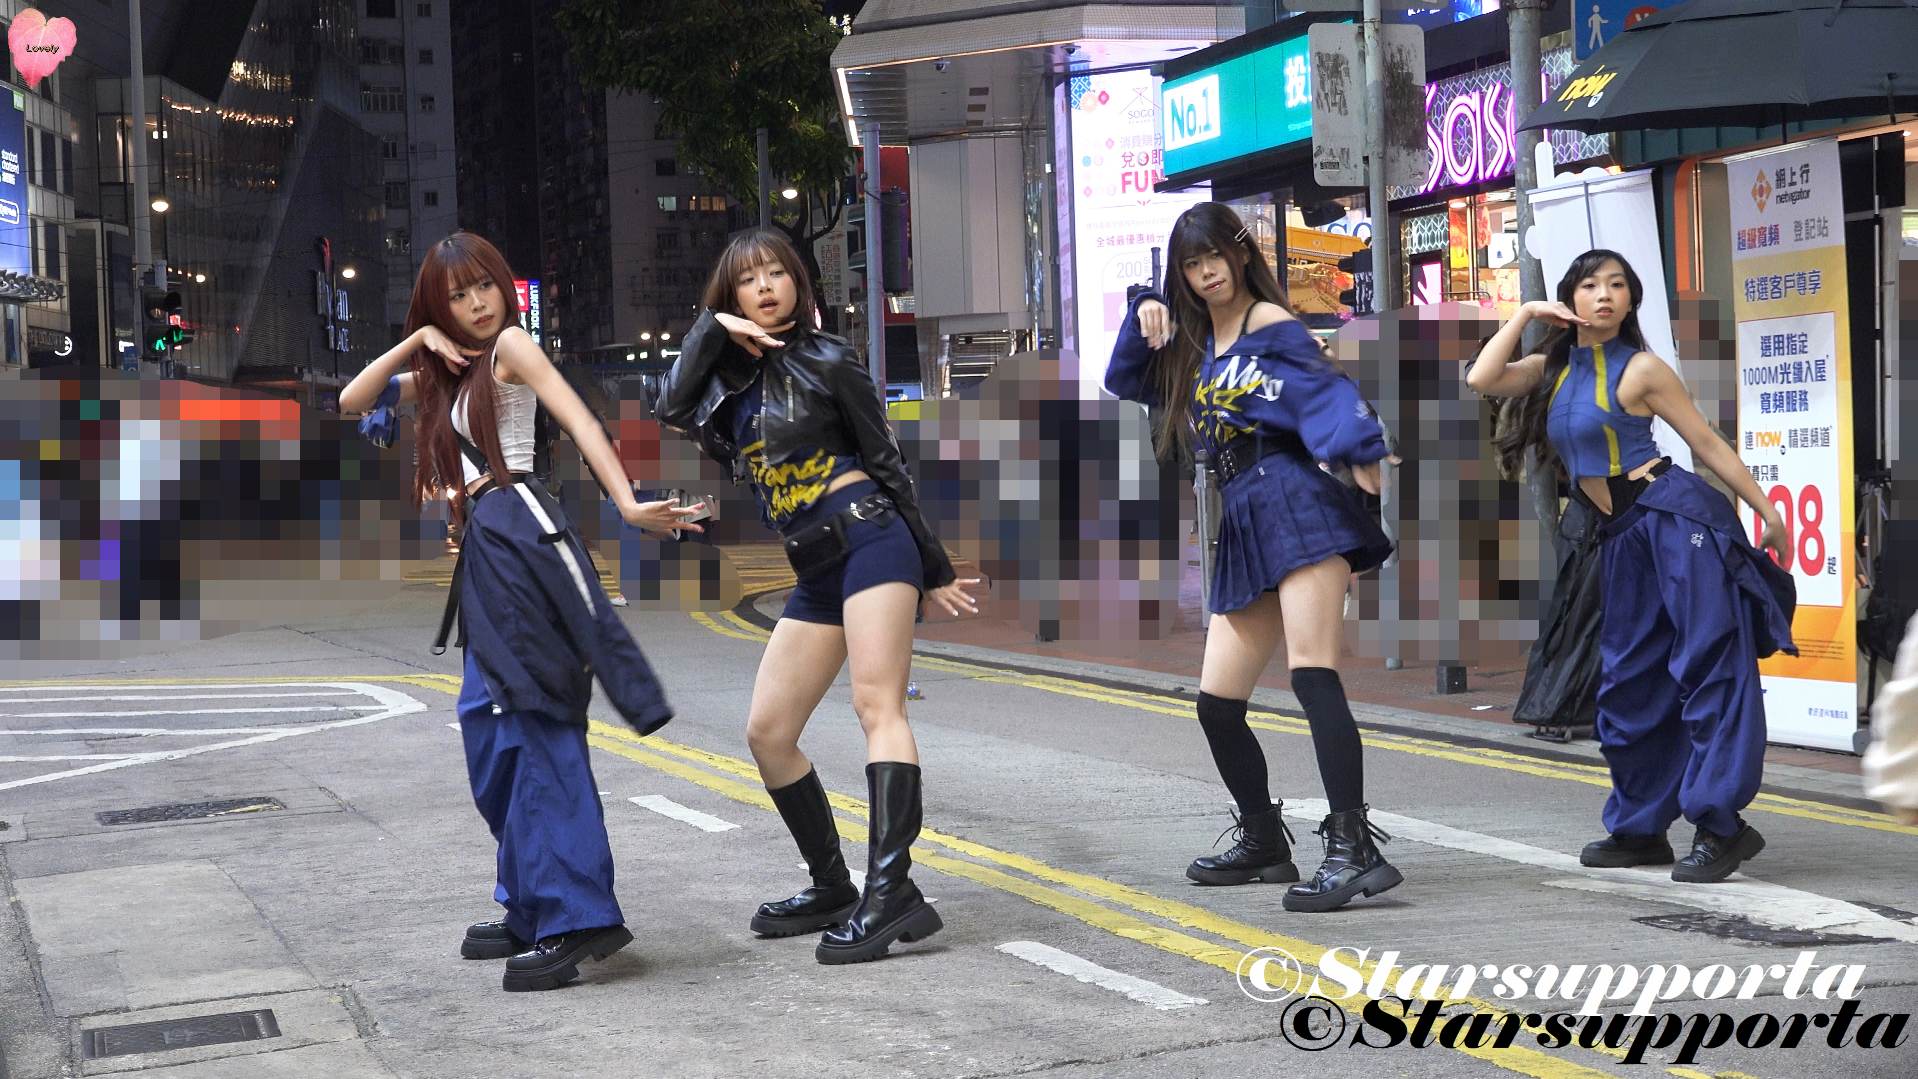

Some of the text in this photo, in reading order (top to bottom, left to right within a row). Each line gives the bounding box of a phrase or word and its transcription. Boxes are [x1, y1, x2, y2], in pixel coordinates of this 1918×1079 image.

[1170, 86, 1213, 142] No.1
[1744, 270, 1821, 303] 特選客戶尊享
[1760, 331, 1809, 358] 選用指定
